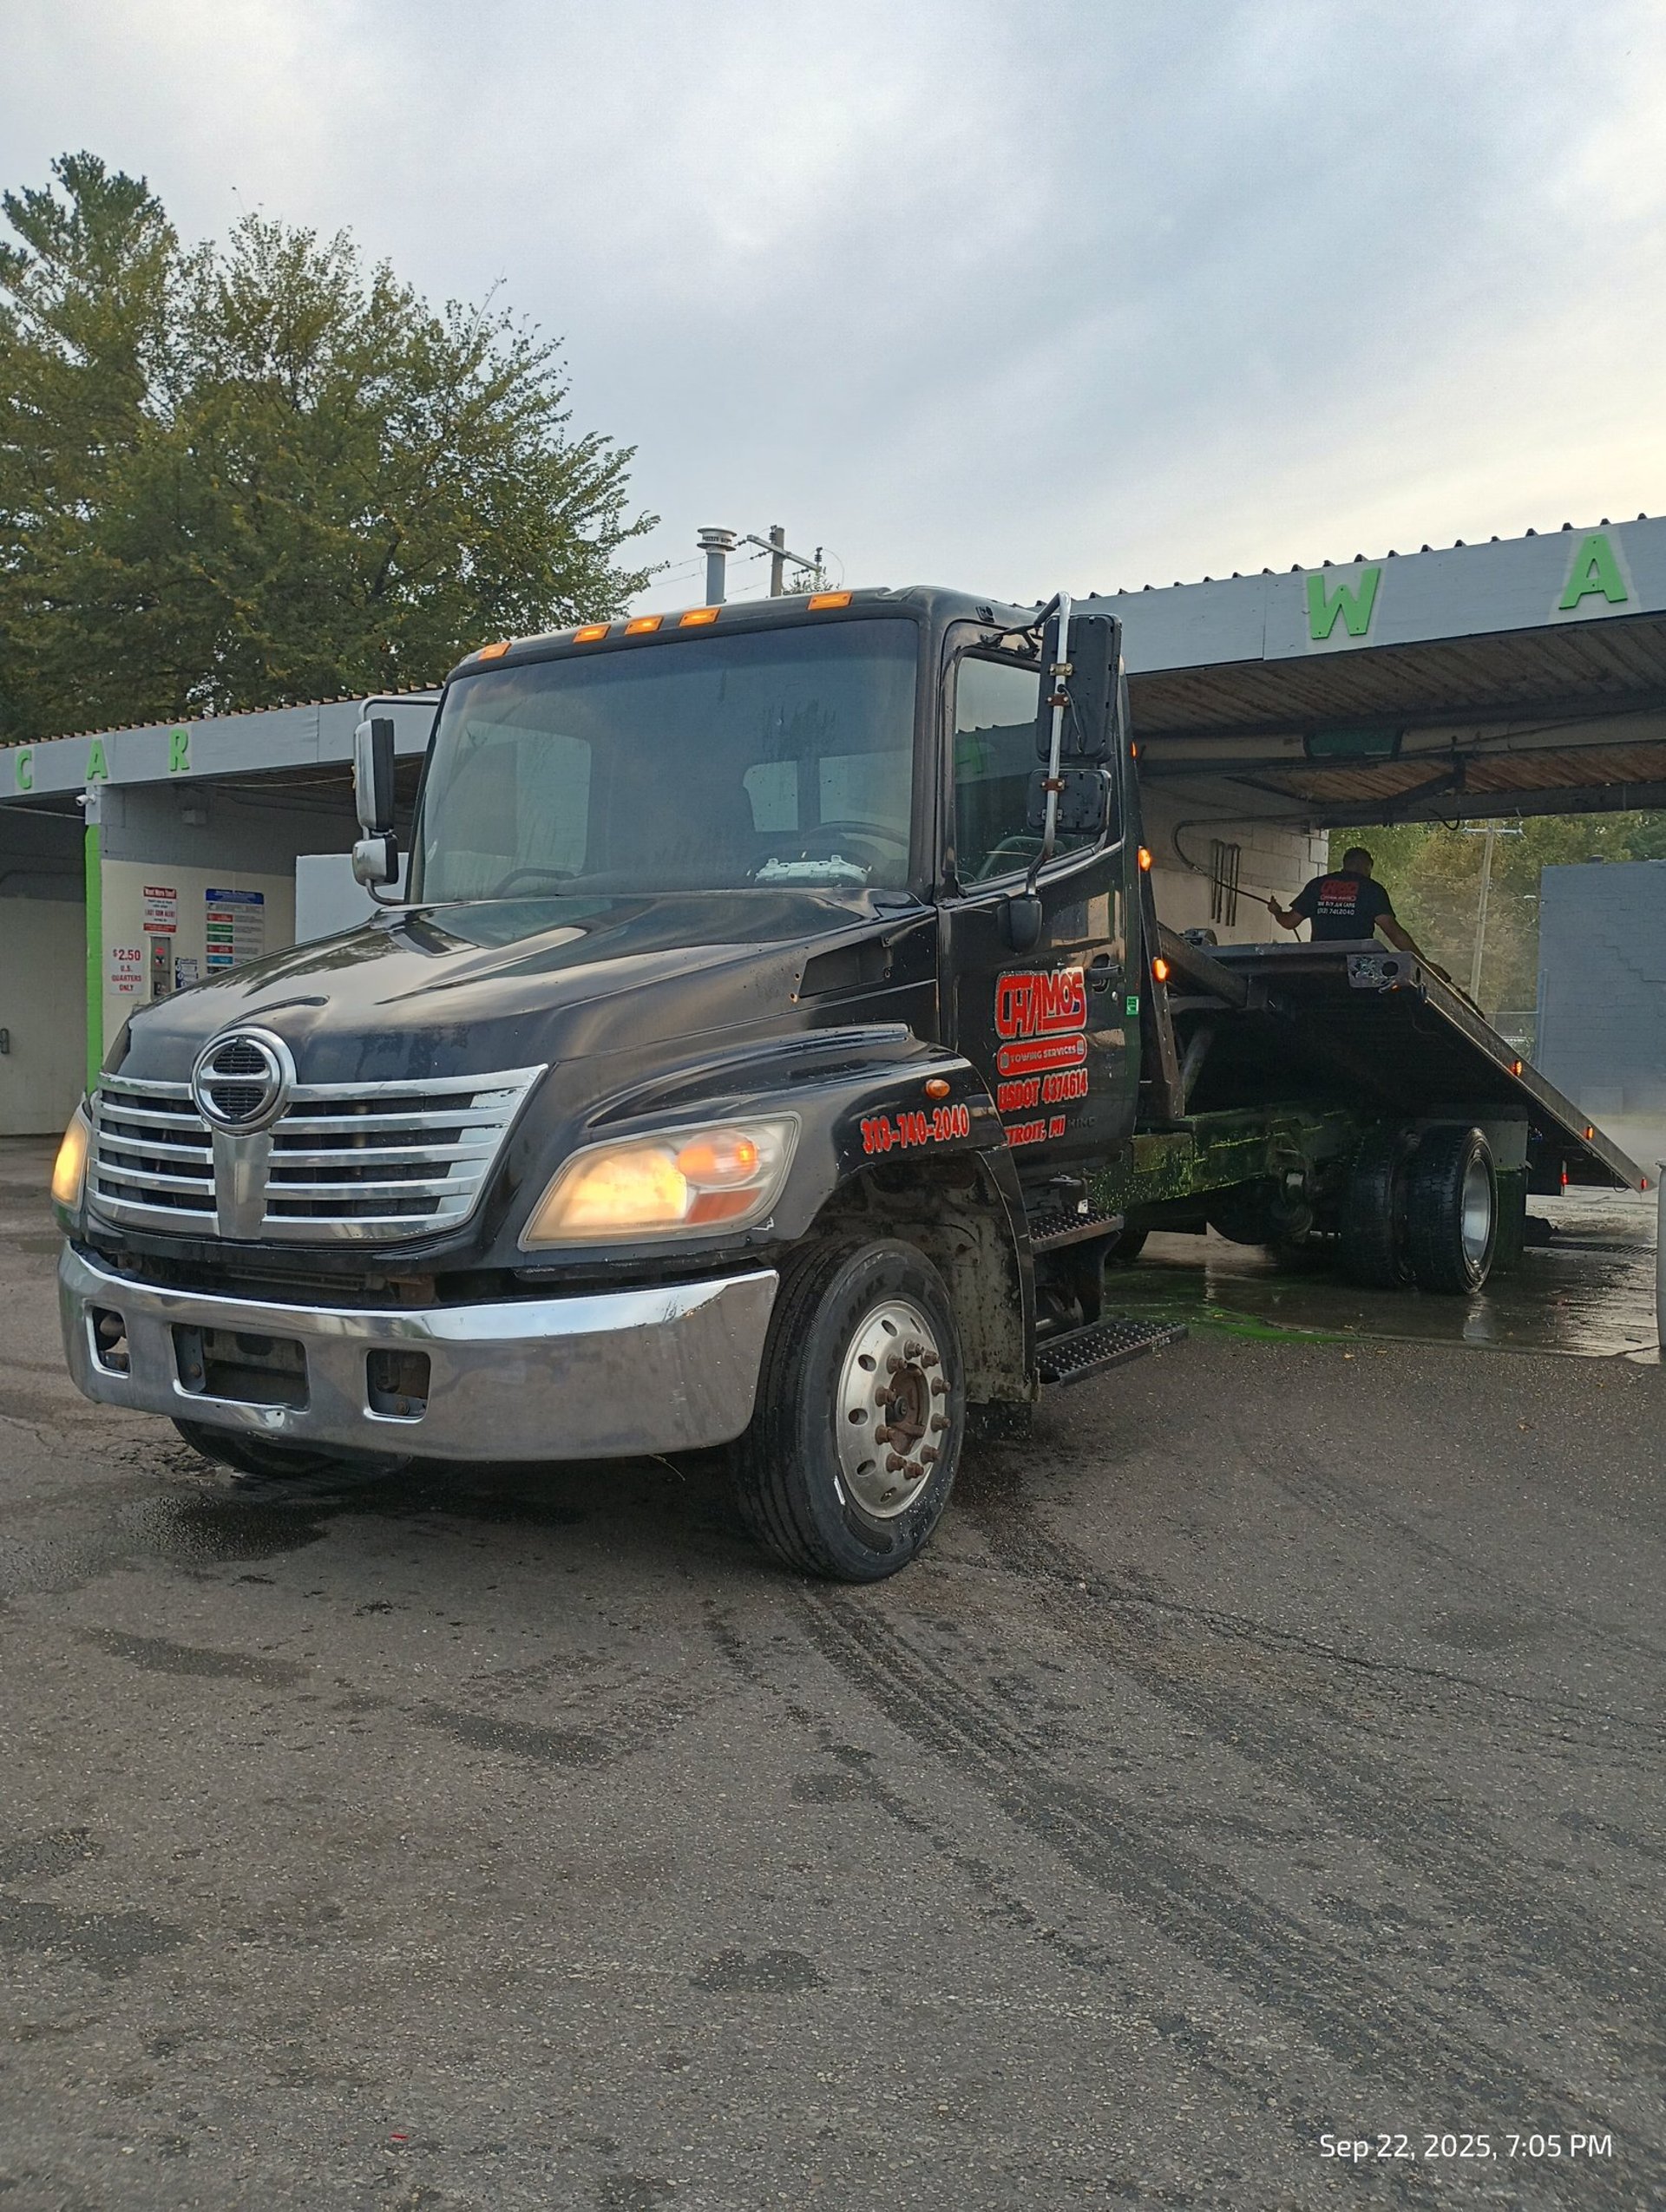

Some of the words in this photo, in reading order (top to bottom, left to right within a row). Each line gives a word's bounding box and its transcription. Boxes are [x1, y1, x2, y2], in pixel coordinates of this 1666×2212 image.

[113, 949, 141, 960] $2.50
[994, 966, 1086, 1039] CHAMOS
[1010, 1051, 1042, 1063] TOWING
[1043, 1045, 1076, 1058] SERVICES
[998, 1077, 1040, 1113] USDOT
[1041, 1068, 1088, 1104] 4374614
[861, 1103, 969, 1155] 313-740-2040
[1004, 1119, 1047, 1147] TROIT,
[1048, 1114, 1066, 1138] MI
